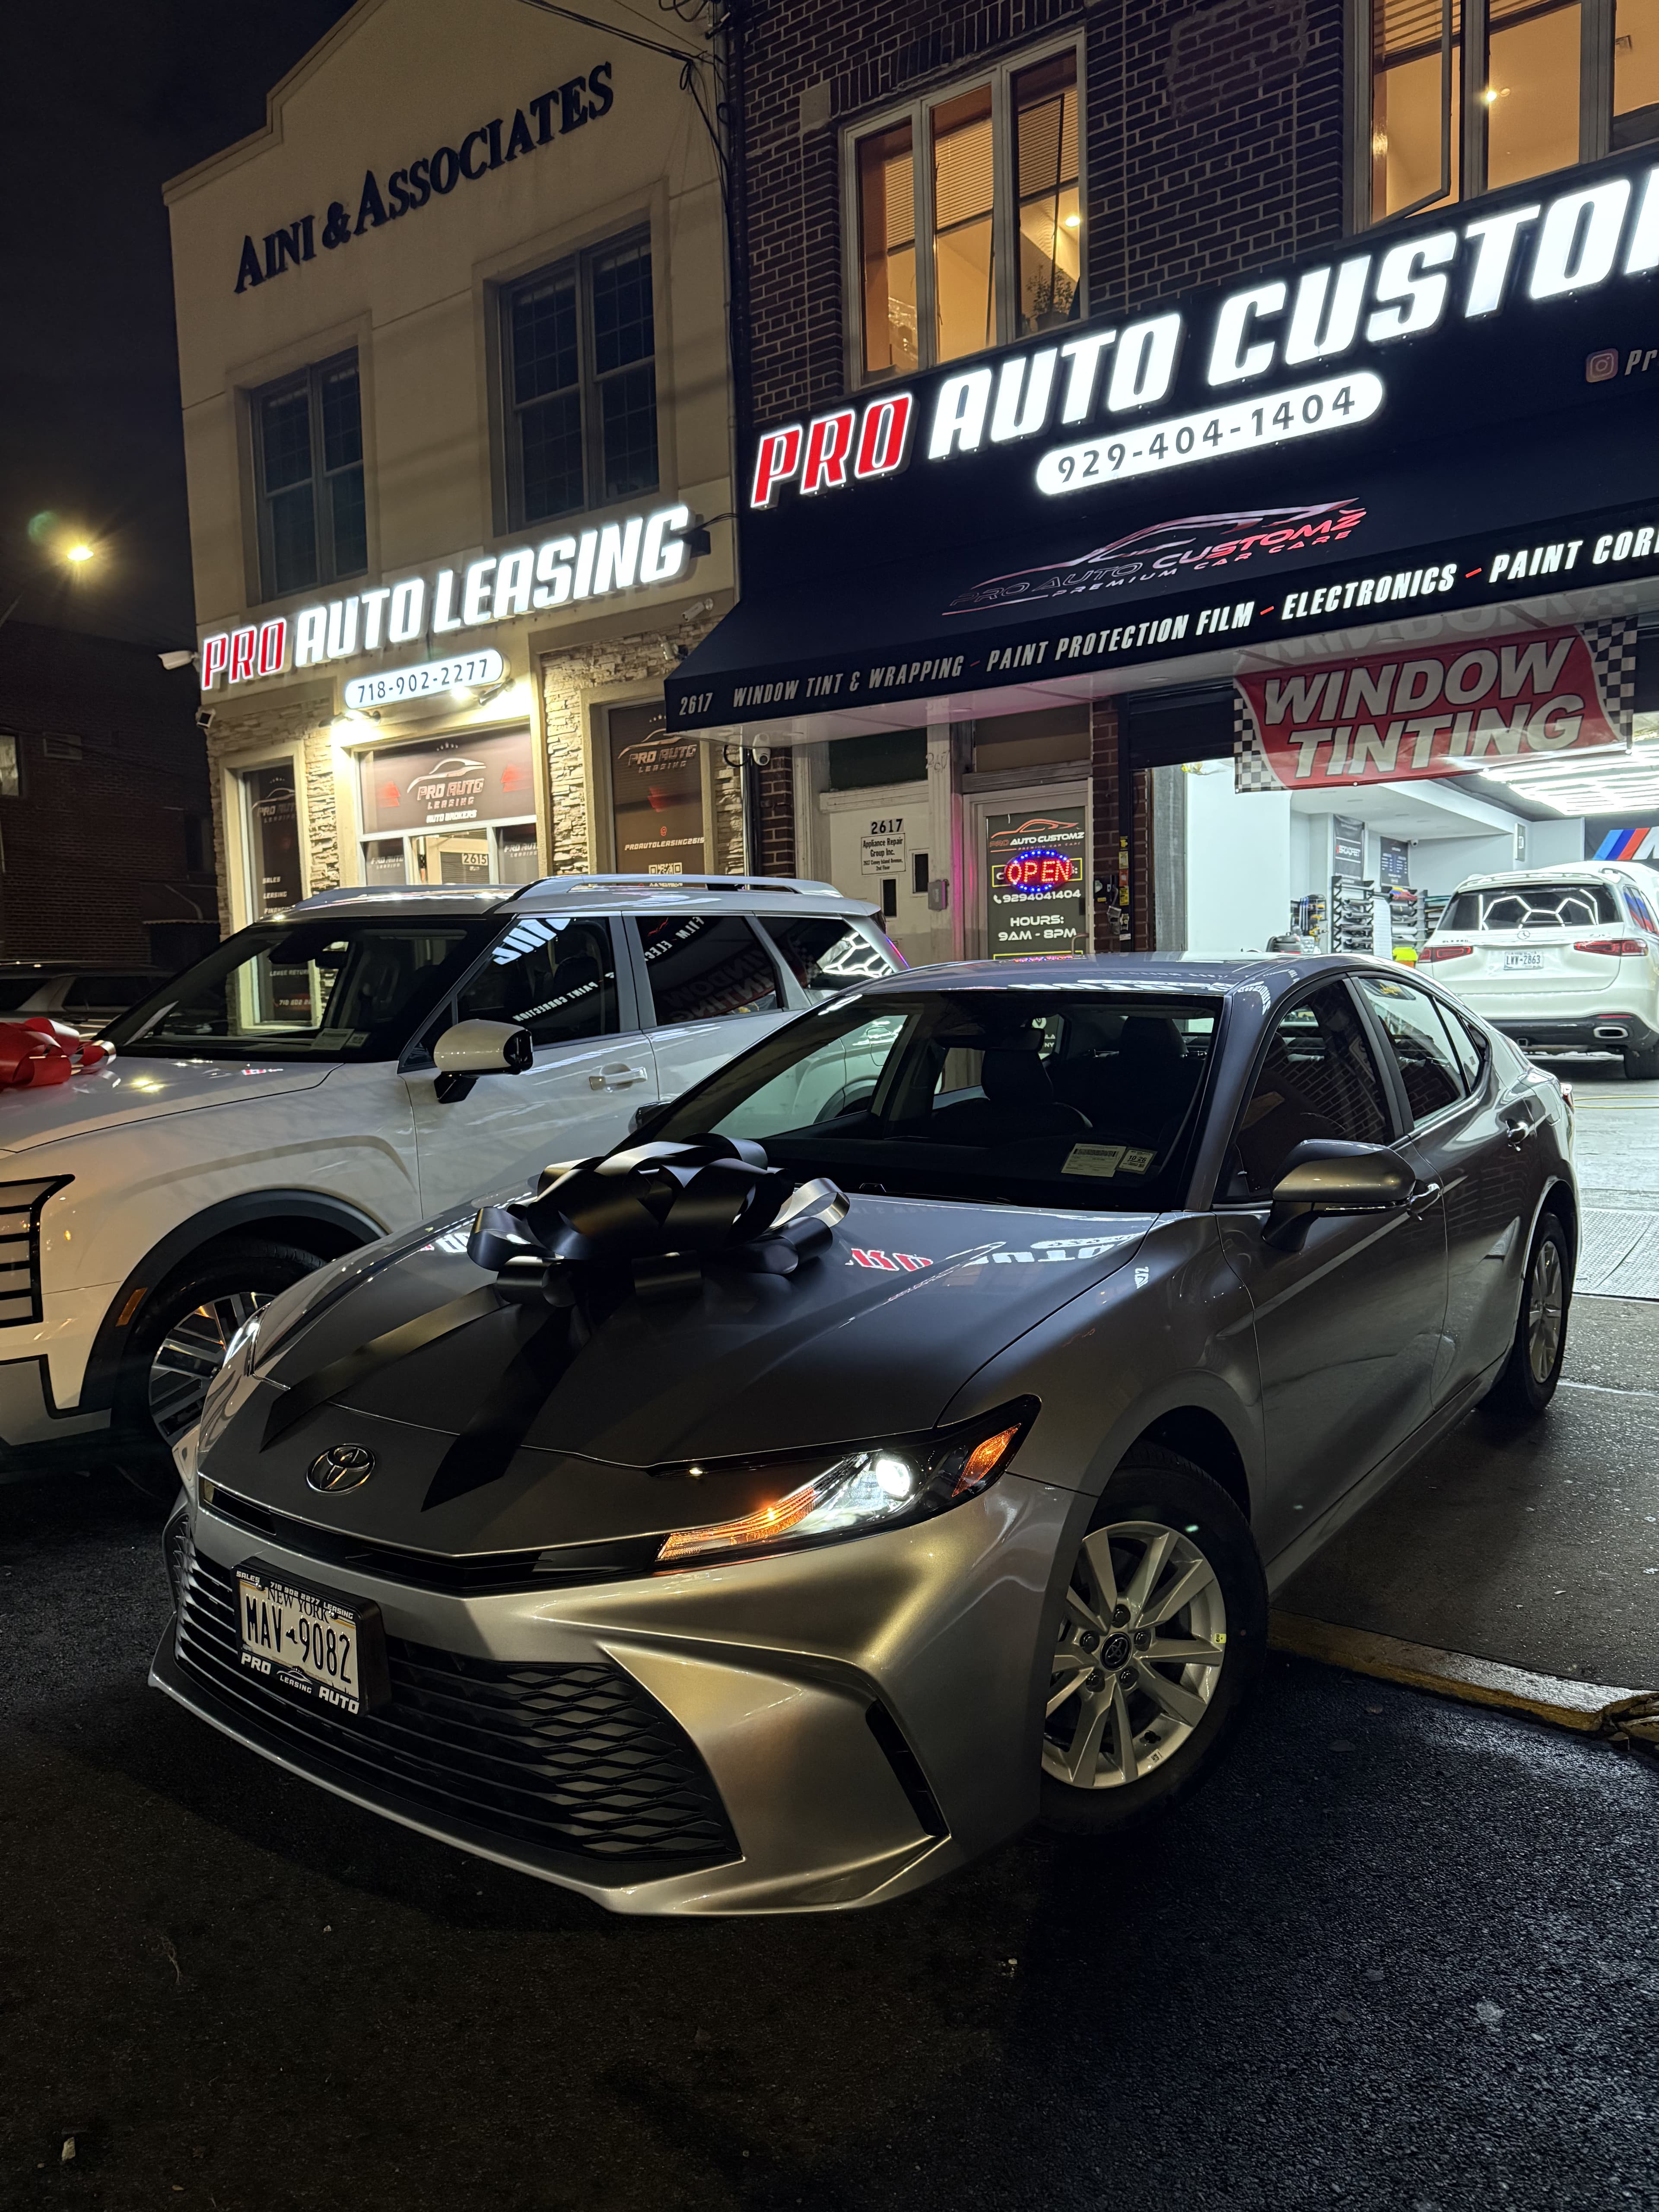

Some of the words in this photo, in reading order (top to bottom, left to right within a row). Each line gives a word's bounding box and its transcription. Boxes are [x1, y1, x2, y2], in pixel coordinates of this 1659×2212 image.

[321, 201, 351, 249] &
[750, 392, 912, 508] PRO
[928, 313, 1181, 460] AUTO
[1057, 386, 1356, 483] 929-404-1404
[1052, 569, 1177, 597] PREMIUM
[1194, 552, 1252, 570] CAR
[1268, 530, 1352, 553] CARE
[950, 582, 1030, 606] PRO
[1032, 563, 1143, 592] AUTO
[201, 617, 287, 692] PRO
[295, 578, 426, 669] AUTO
[433, 504, 690, 634] LEASING
[679, 693, 713, 716] 2617
[733, 679, 804, 708] WINDOW
[806, 673, 843, 698] TINT
[850, 671, 860, 692] &
[868, 655, 965, 689] WRAPPING
[985, 641, 1048, 672] PAINT
[1055, 614, 1187, 661] PROTECTION
[1195, 601, 1255, 636] FILM
[1281, 563, 1458, 620] ELECTRONICS
[1489, 540, 1583, 583] PAINT
[1592, 527, 1659, 564] COR
[357, 659, 488, 704] 718-902-2277
[1263, 637, 1577, 726] WINDOW
[1288, 694, 1585, 779] TINTING
[628, 750, 657, 767] PRO
[659, 744, 697, 761] AUTO
[639, 761, 687, 774] LEASING
[417, 783, 445, 801] PRO
[447, 778, 484, 796] AUTO
[427, 796, 474, 810] LEASING
[871, 818, 903, 835] 2617
[625, 837, 705, 851] PROAUTOLEASING2615
[863, 839, 886, 849] Appliance
[887, 837, 903, 846] Repair
[1010, 836, 1037, 845] AUTO
[1037, 832, 1085, 842] CUSTOMZ
[464, 854, 487, 864] 2615
[870, 849, 884, 858] Group
[1007, 859, 1071, 884] OPEN
[1002, 889, 1081, 903] 9294041404
[1010, 915, 1064, 927] HOURS:
[998, 930, 1032, 941] 9AM
[1044, 928, 1077, 939] 8PM
[1524, 955, 1541, 964] 2863
[236, 1571, 261, 1583] SALES
[284, 1586, 299, 1597] 902
[301, 1593, 320, 1604] 2277
[323, 1602, 354, 1620] LEASING
[265, 1587, 294, 1609] NEW
[298, 1599, 330, 1624] YORK
[299, 1616, 352, 1684] 9082
[241, 1653, 271, 1675] PRO
[280, 1675, 312, 1694] LEASING
[318, 1686, 359, 1714] AUTO
